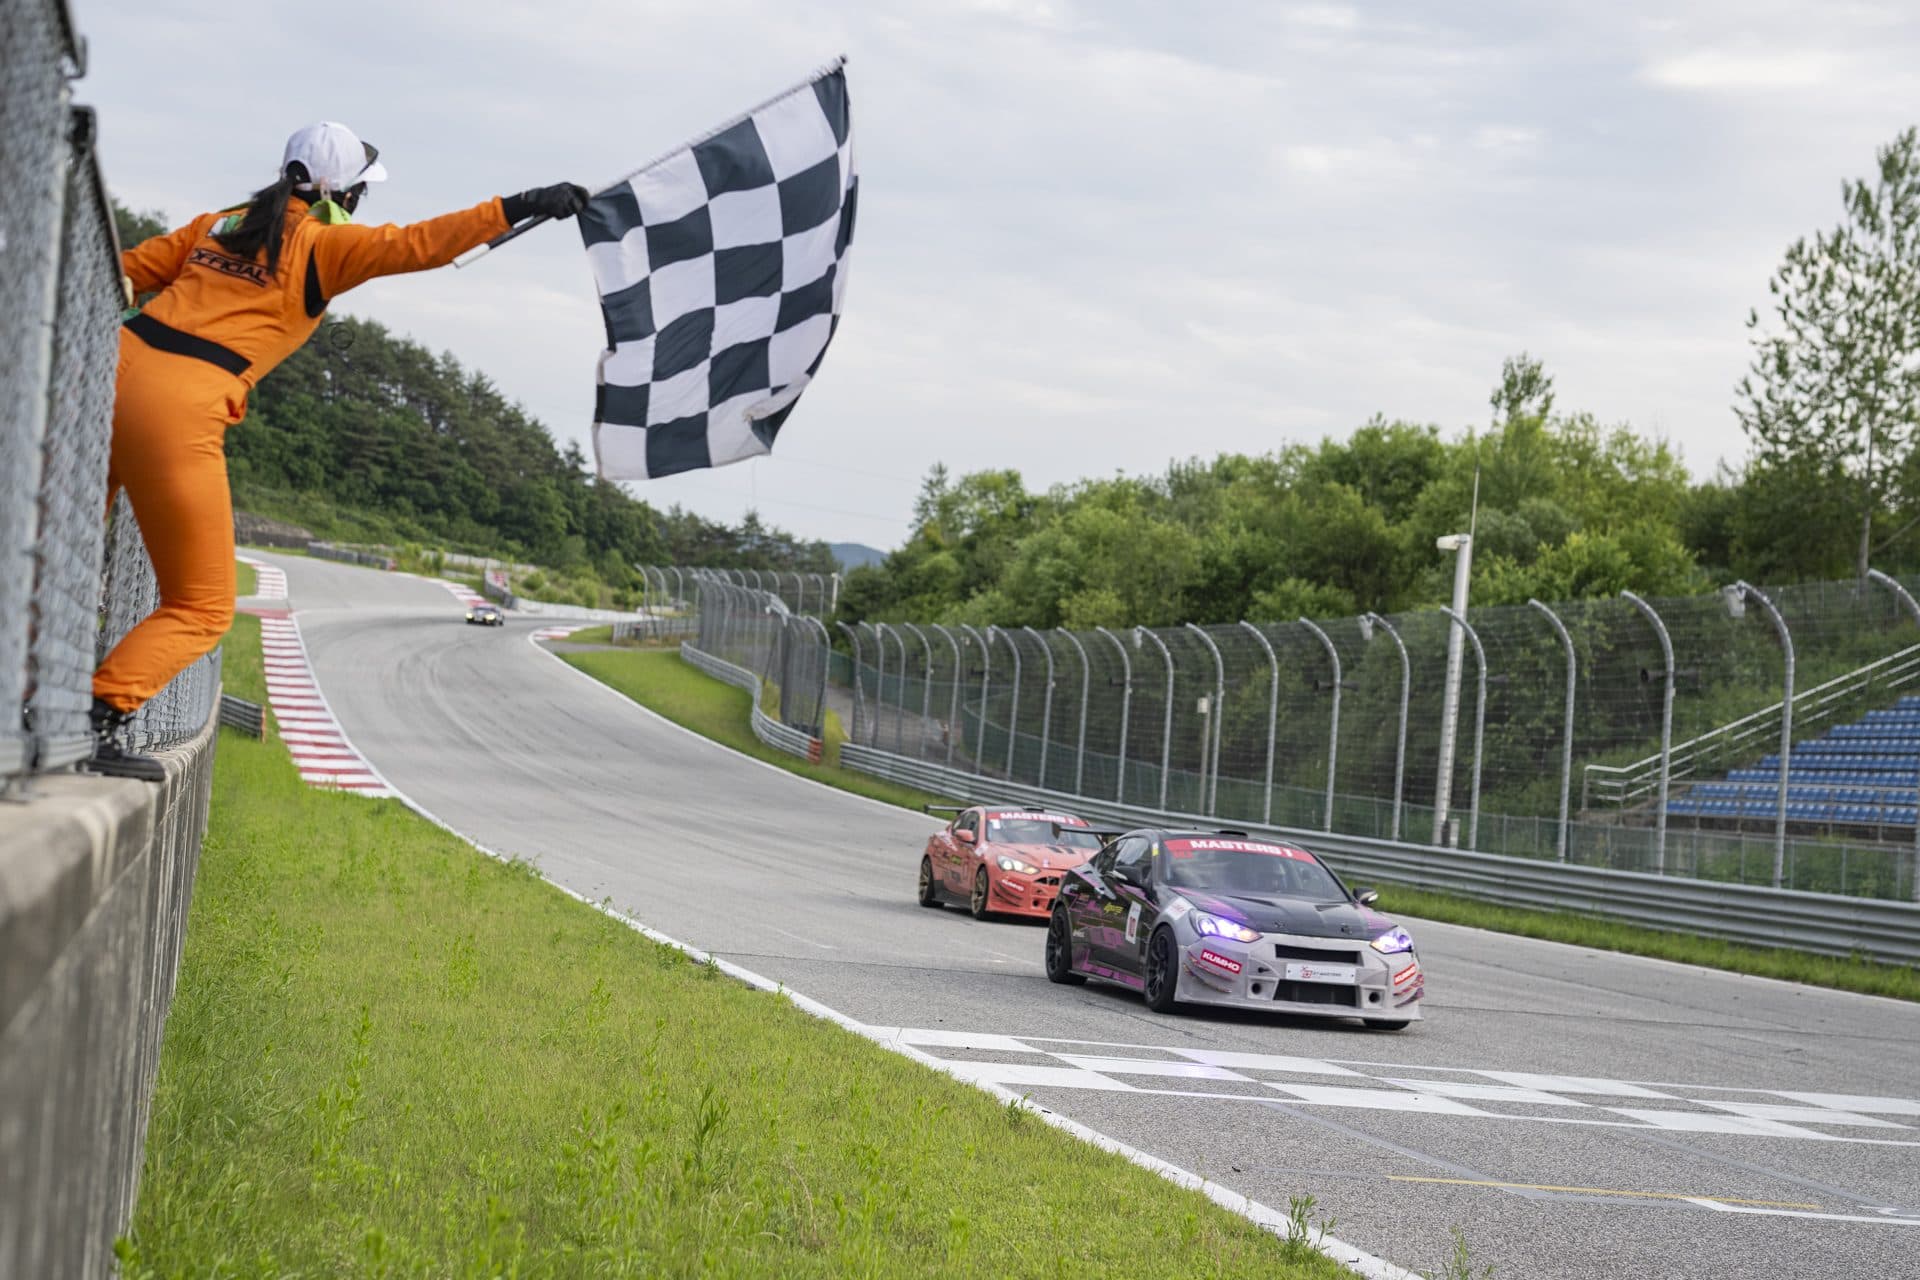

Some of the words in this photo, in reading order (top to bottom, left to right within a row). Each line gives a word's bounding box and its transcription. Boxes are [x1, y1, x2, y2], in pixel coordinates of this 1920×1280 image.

[999, 812, 1066, 824] MASTERS
[1190, 839, 1281, 855] MASTERS
[1202, 951, 1240, 972] KUMHO
